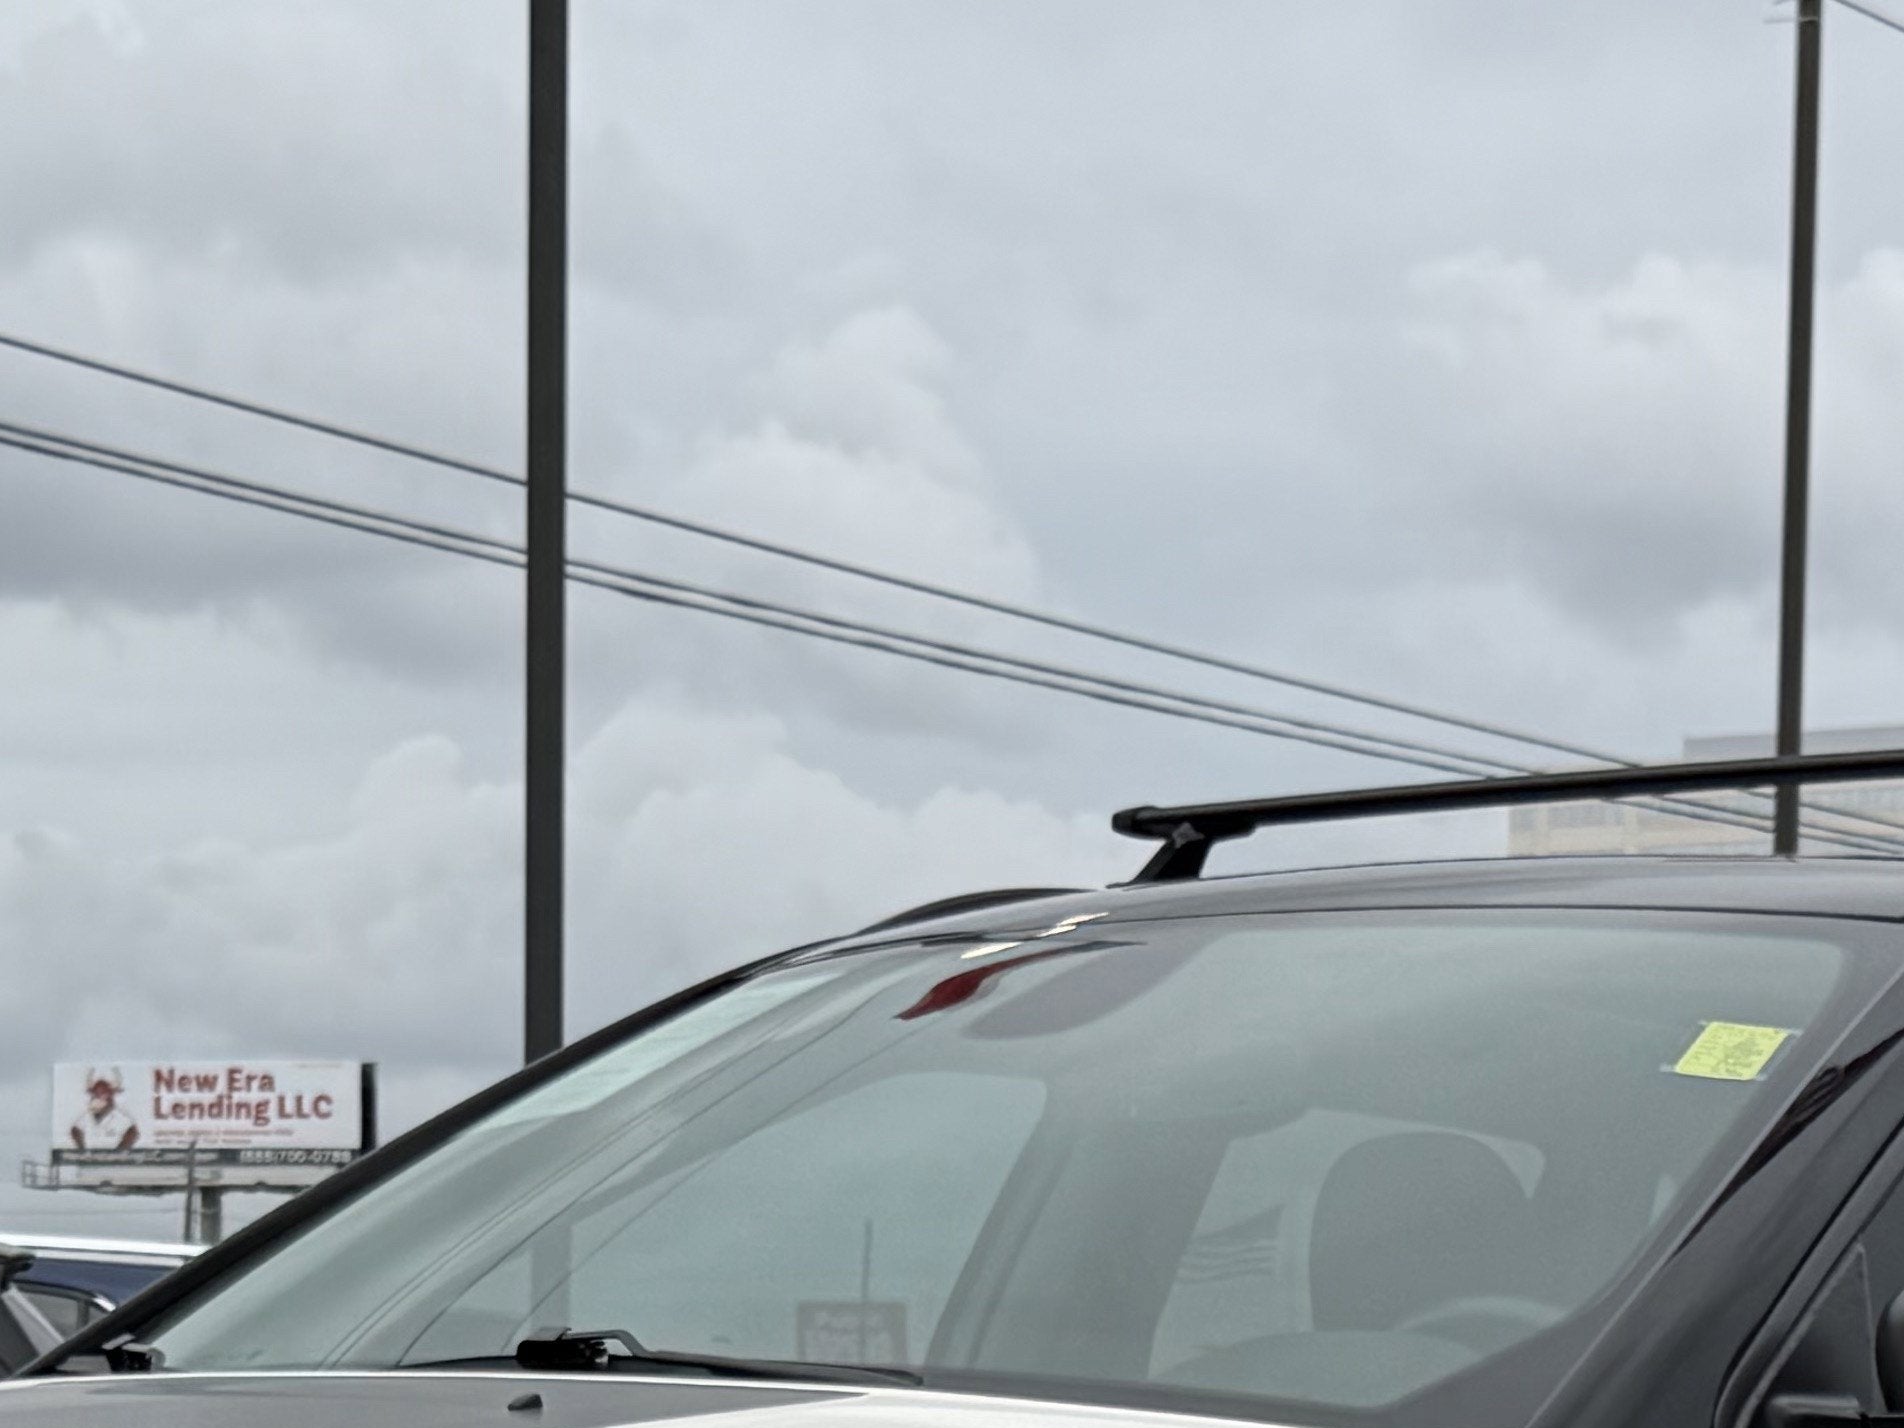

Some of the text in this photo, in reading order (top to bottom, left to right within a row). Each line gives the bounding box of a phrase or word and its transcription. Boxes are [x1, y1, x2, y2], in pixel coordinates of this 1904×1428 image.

[153, 1068, 275, 1093] New Era
[153, 1094, 333, 1126] Lending LLC
